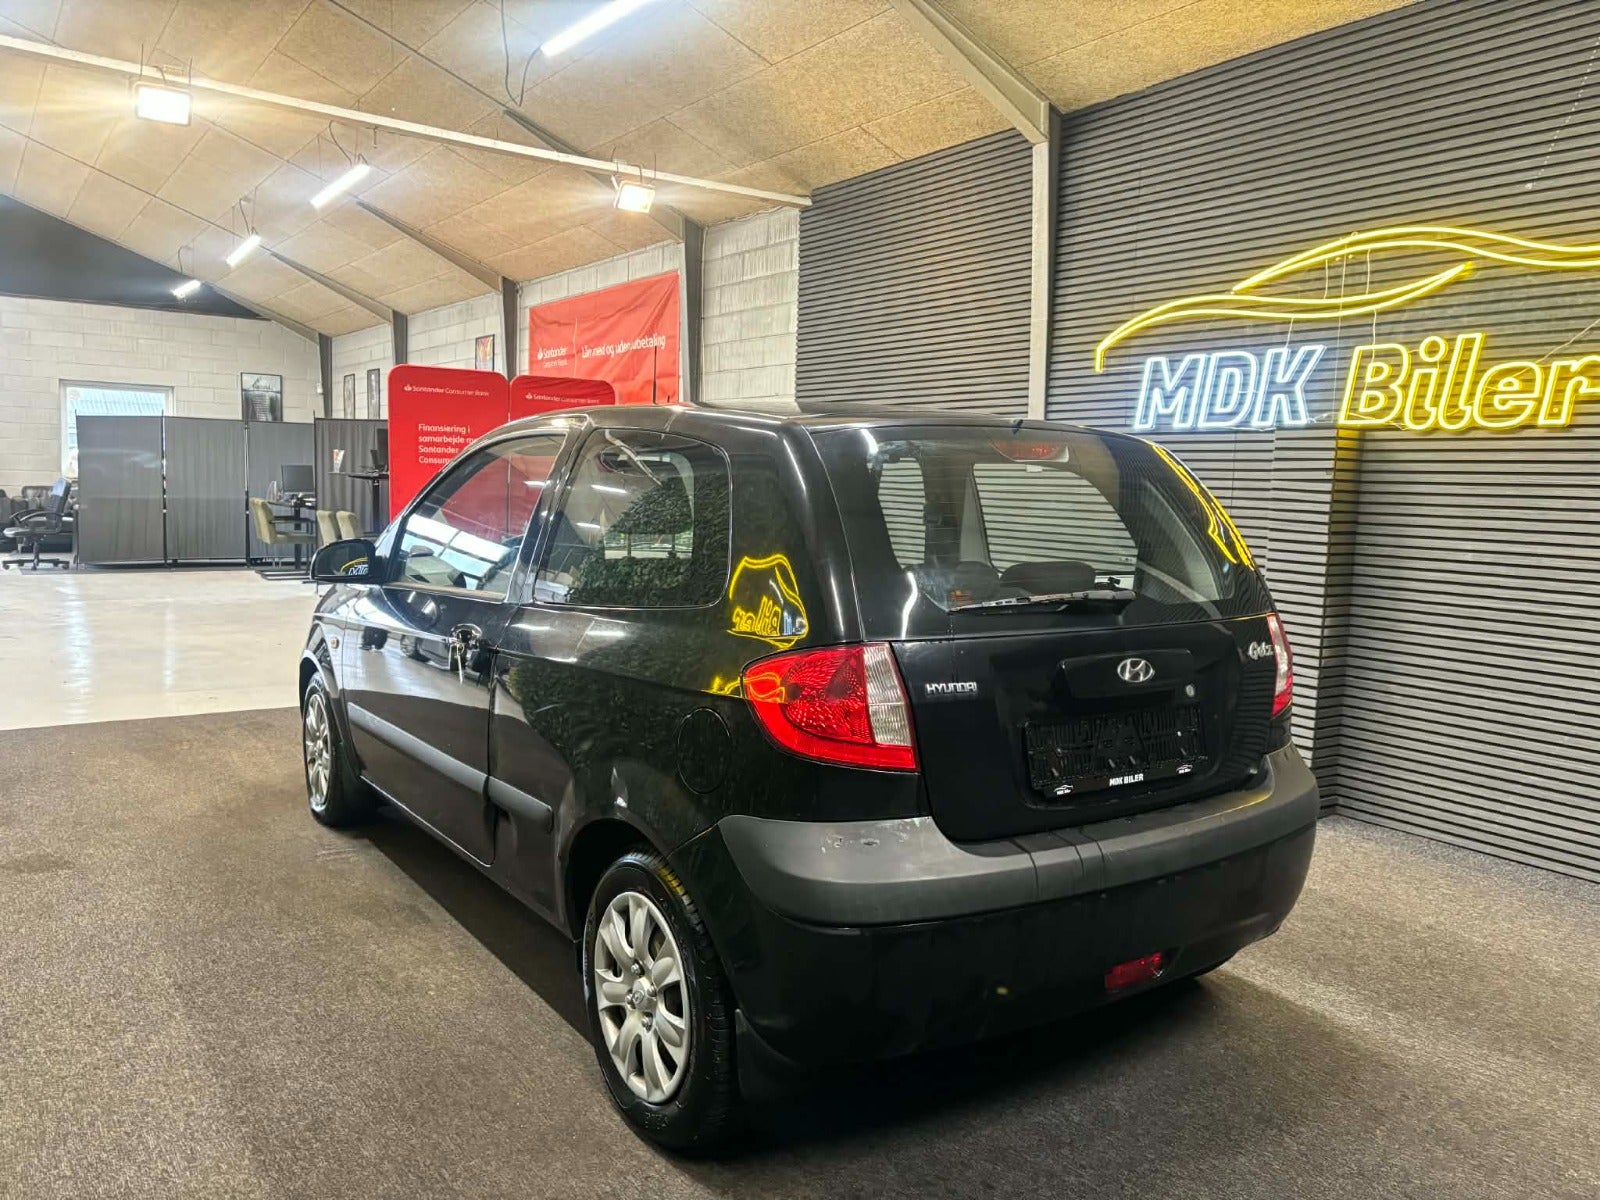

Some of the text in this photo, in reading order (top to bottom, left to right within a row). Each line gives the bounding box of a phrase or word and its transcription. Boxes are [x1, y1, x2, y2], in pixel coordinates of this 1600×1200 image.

[1133, 332, 1600, 431] MDK Biler
[412, 385, 444, 393] Santander
[418, 423, 470, 434] Finansiering i
[418, 435, 465, 444] samarbejde
[418, 445, 458, 453] Santander
[925, 681, 978, 695] HYUNDAI
[1123, 773, 1144, 785] BILER
